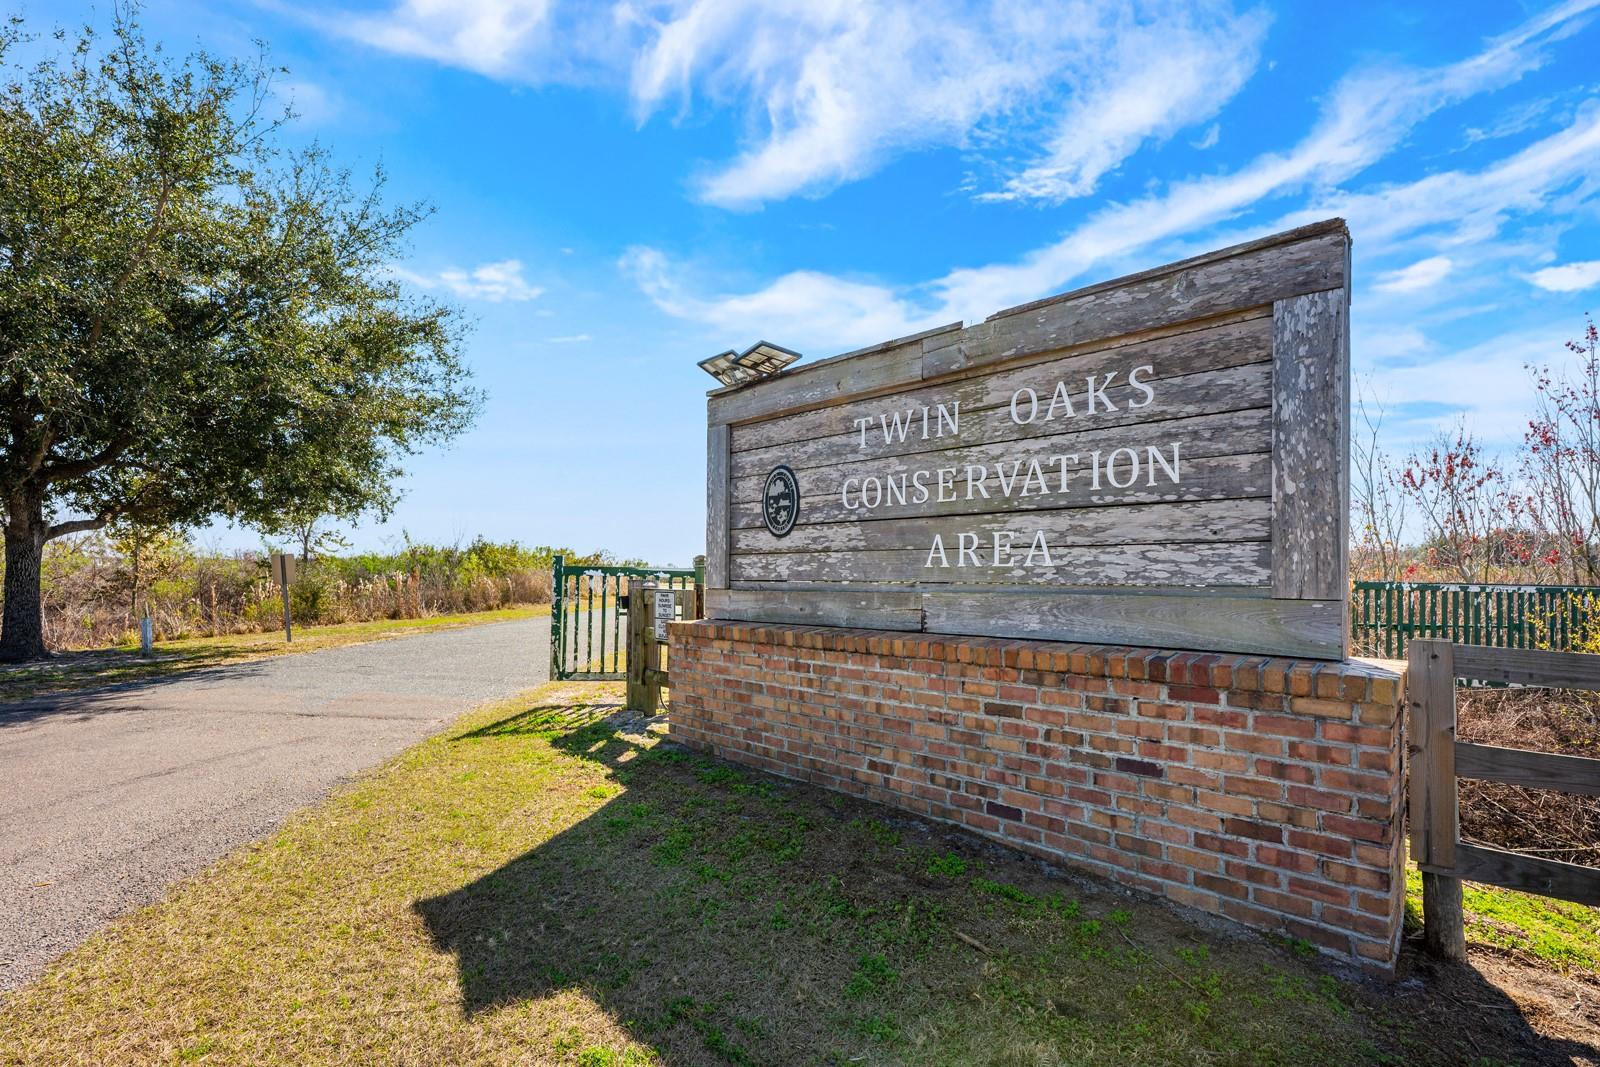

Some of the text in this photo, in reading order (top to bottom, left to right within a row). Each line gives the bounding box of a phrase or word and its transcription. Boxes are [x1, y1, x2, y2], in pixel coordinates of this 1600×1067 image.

[853, 365, 1155, 449] TWIN OAKS
[842, 442, 1181, 509] CONSERVATION
[924, 530, 1055, 568] AREA
